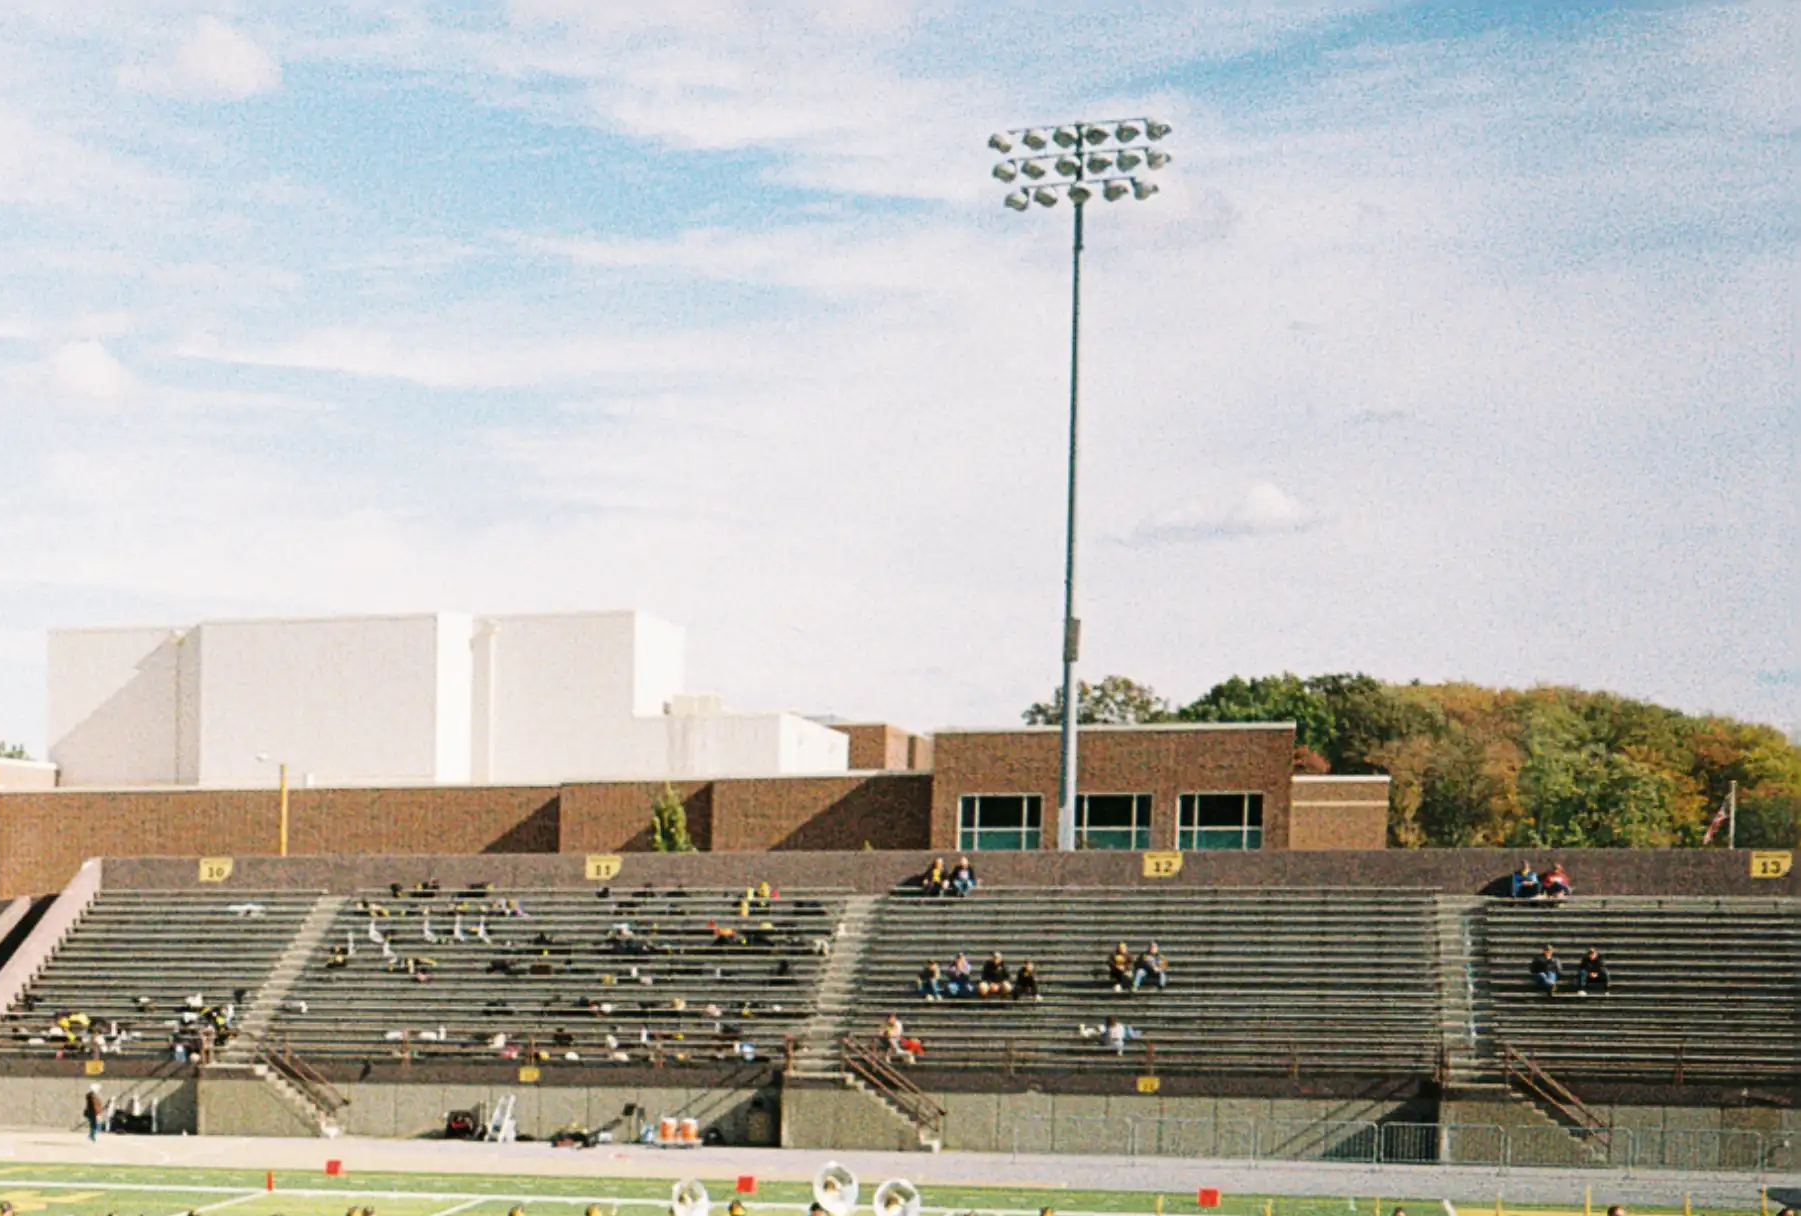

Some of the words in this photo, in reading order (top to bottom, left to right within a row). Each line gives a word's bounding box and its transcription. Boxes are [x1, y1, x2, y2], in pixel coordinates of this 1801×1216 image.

[207, 866, 225, 878] 10
[595, 864, 610, 877] 11
[1154, 860, 1173, 873] 12
[1760, 860, 1782, 875] 13
